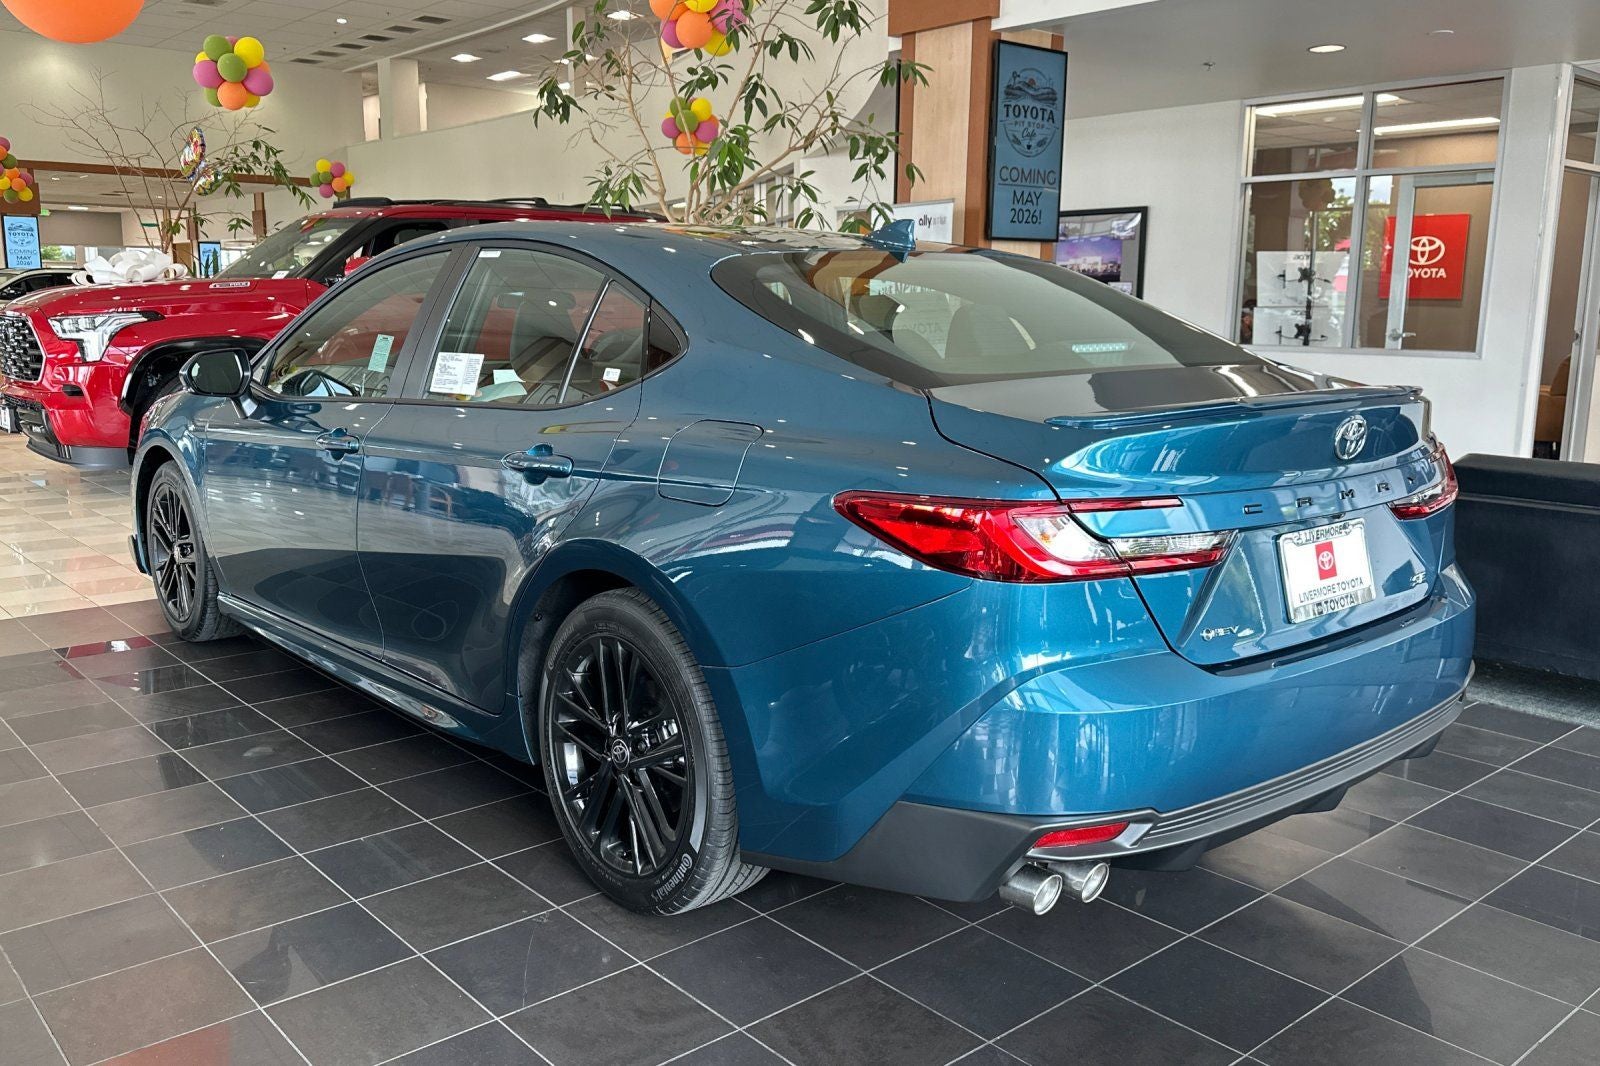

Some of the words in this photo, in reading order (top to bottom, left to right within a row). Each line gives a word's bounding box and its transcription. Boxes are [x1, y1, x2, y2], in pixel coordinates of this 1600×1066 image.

[1003, 104, 1055, 124] TOYOTA
[999, 165, 1057, 186] COMING
[1012, 189, 1043, 207] MAY
[918, 214, 933, 229] ally
[1009, 208, 1042, 225] 2026!
[1408, 266, 1447, 279] OYOTA
[1304, 524, 1343, 543] LIVERMORE
[1299, 586, 1336, 603] LIVERMORE
[1336, 577, 1364, 592] TOYOTA
[1324, 593, 1355, 612] TOYOTA
[656, 853, 693, 901] Continental
